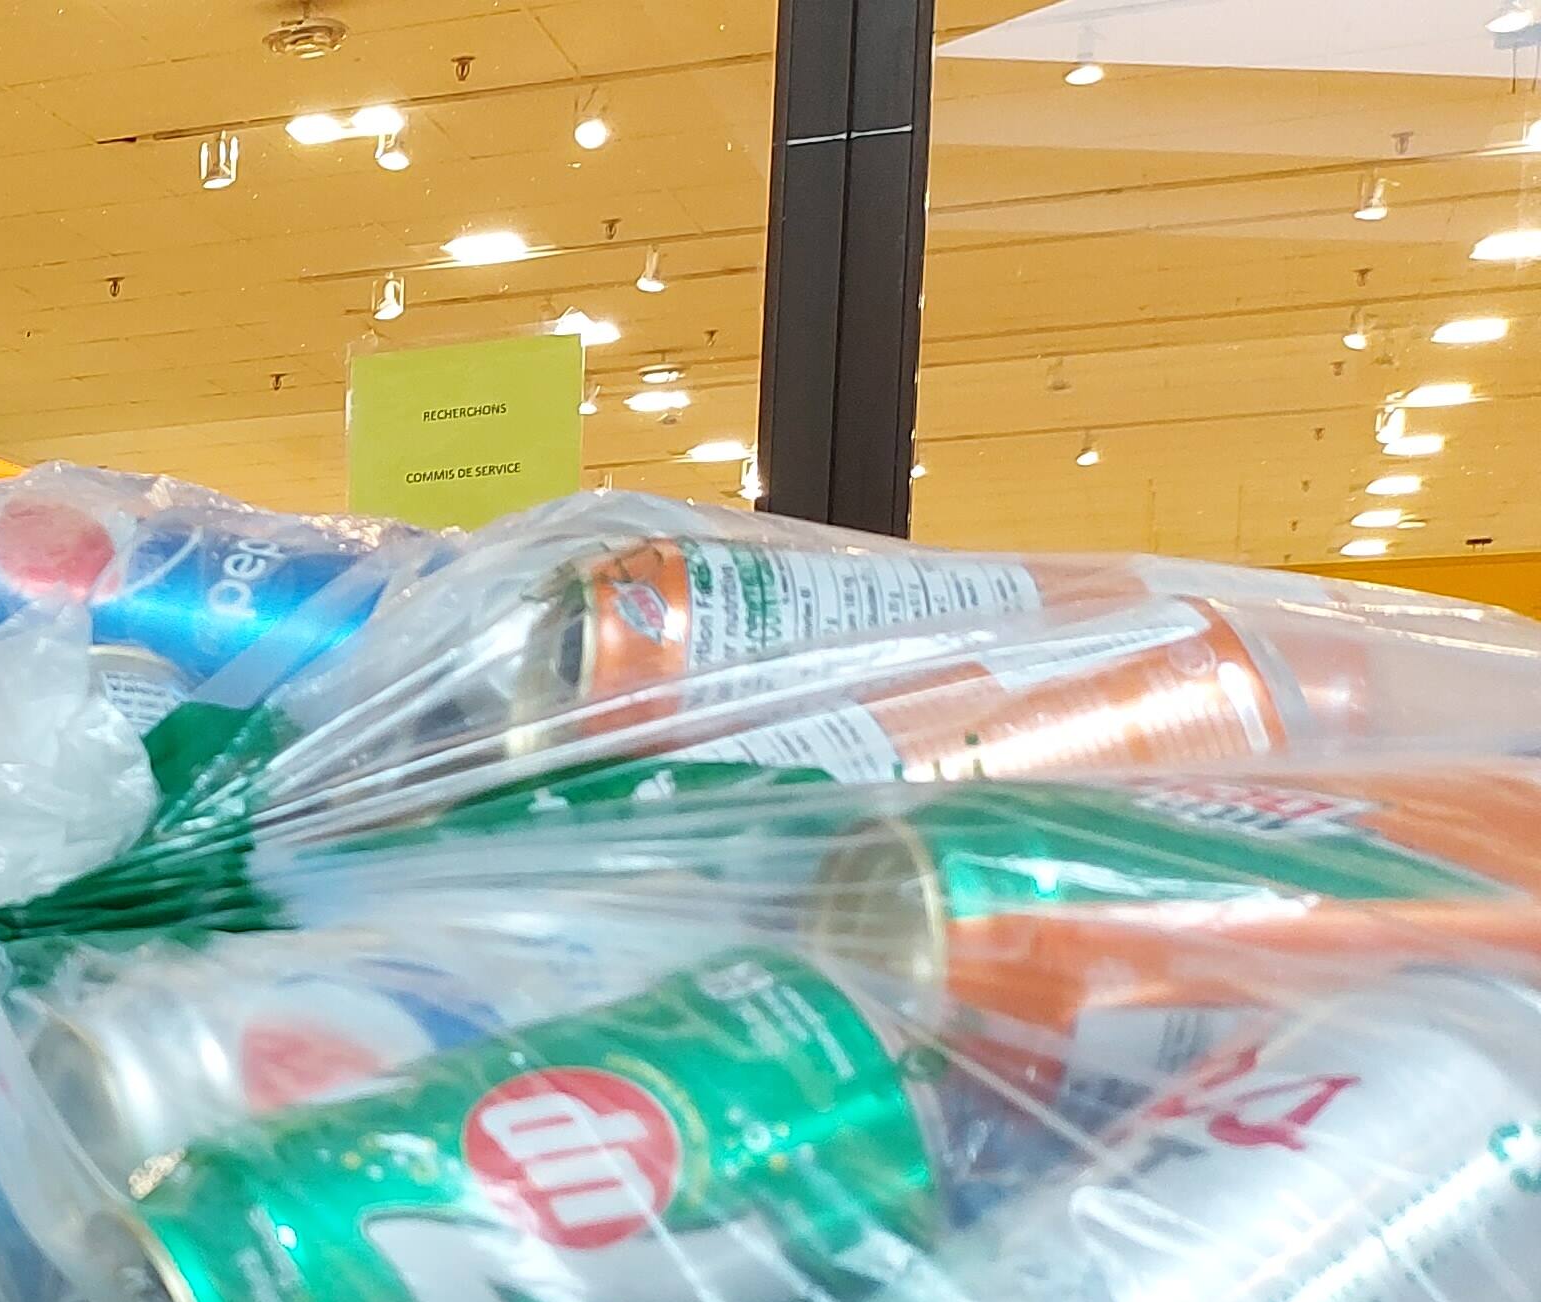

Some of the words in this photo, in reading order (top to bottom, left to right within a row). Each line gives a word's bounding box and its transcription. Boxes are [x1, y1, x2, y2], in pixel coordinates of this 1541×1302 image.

[422, 402, 507, 422] RECHERCHONS
[405, 468, 455, 484] COMMIS
[457, 466, 473, 479] DE
[475, 461, 521, 479] SERVICE
